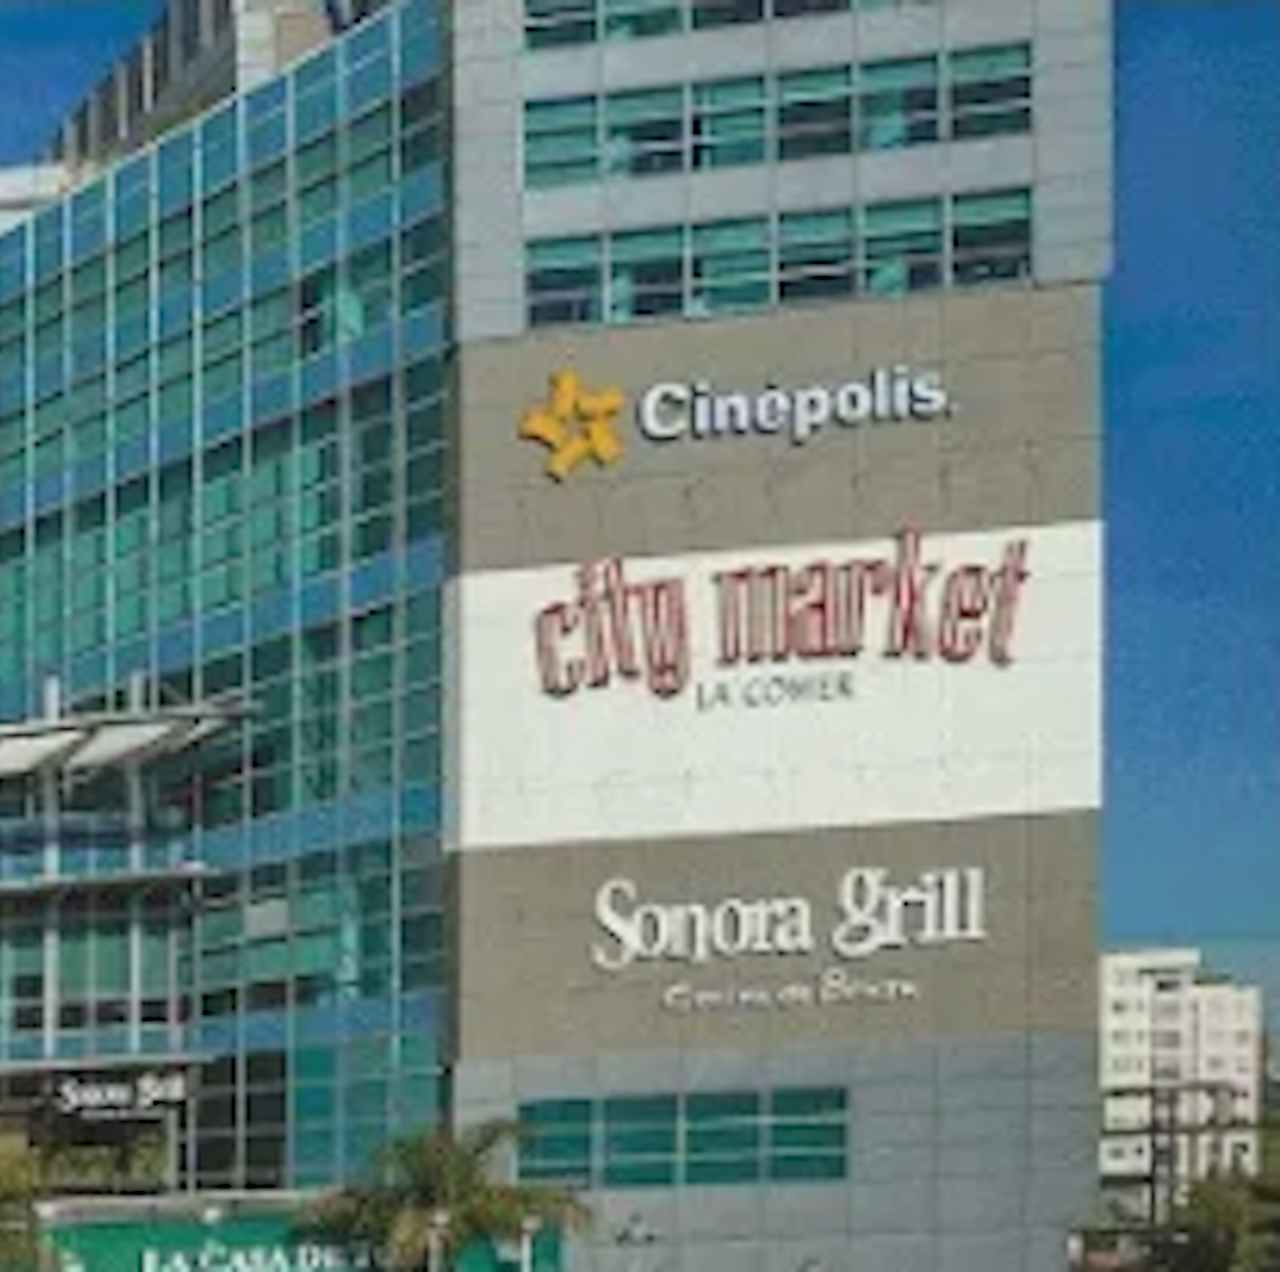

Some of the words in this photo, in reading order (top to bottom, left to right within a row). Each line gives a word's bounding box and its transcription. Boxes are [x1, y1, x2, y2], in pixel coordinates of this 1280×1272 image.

[535, 556, 689, 698] city
[712, 520, 1030, 668] market
[592, 876, 815, 971] Sonora
[832, 866, 989, 957] grill
